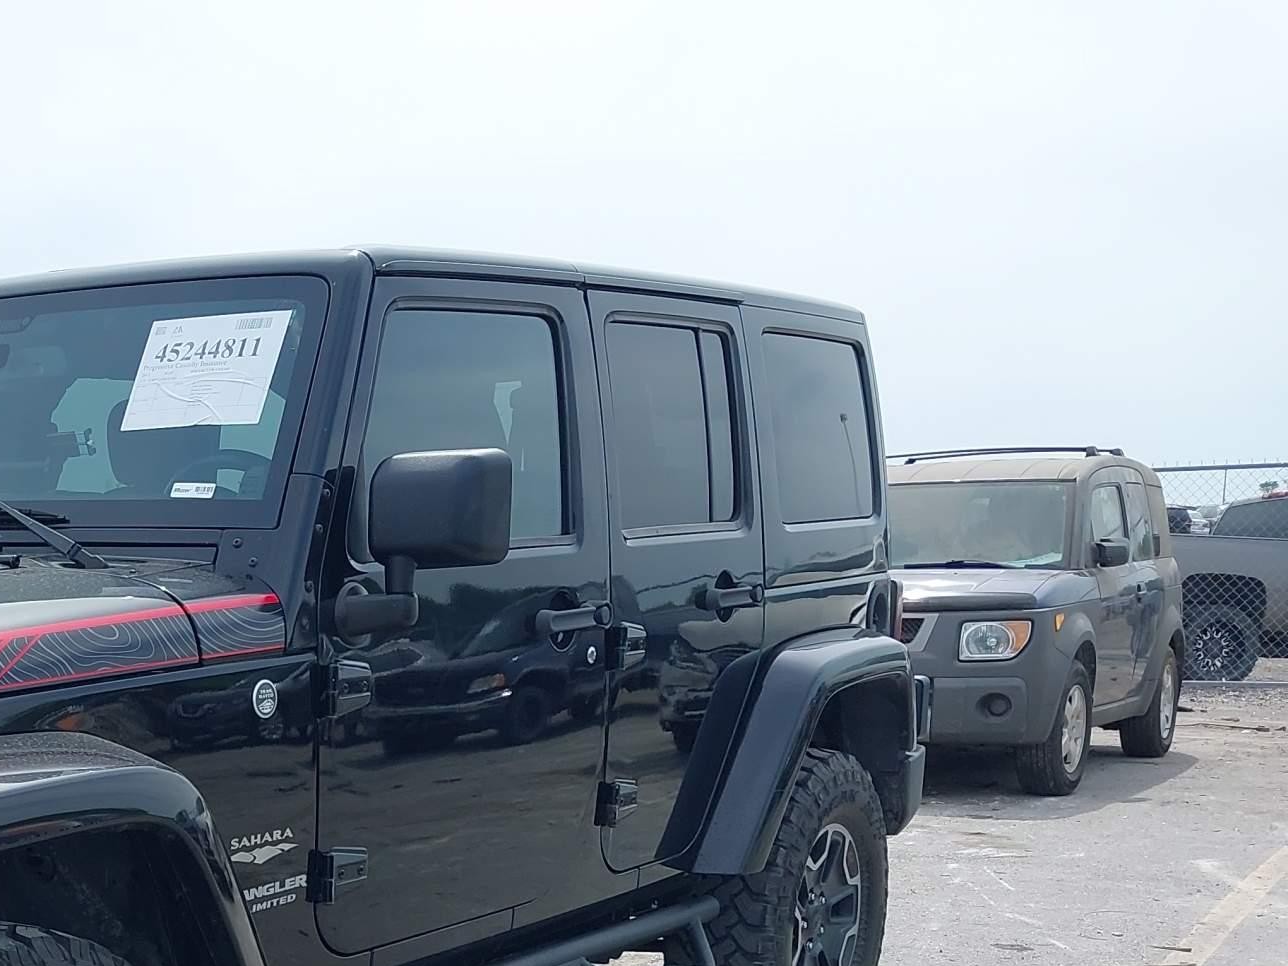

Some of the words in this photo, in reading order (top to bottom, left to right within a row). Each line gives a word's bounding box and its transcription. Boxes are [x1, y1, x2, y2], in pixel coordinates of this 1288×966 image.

[153, 337, 262, 363] 45244811
[230, 827, 294, 850] SAHARA
[251, 893, 297, 913] IMITED
